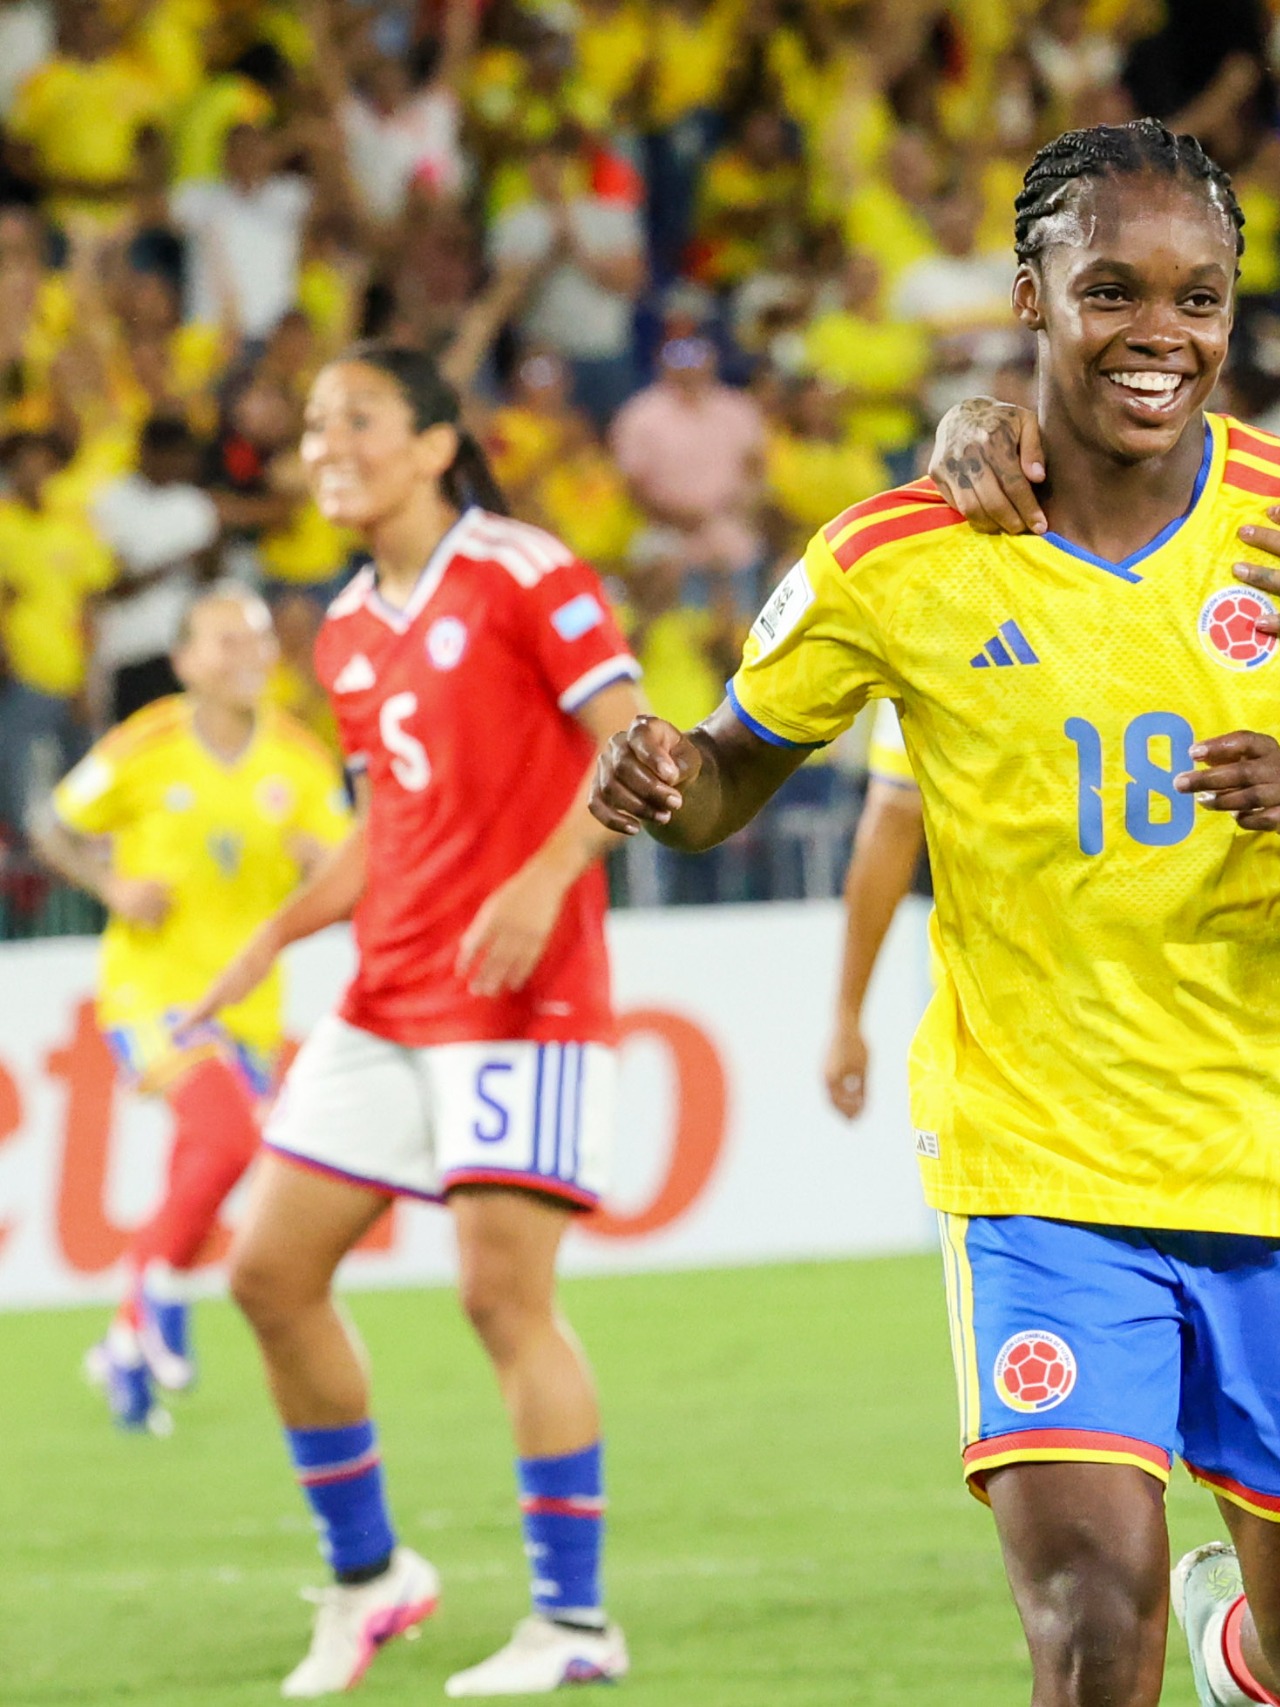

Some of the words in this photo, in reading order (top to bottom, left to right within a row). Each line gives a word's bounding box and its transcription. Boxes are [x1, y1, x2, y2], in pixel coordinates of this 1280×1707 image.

[379, 691, 432, 793] 5
[1063, 710, 1196, 856] 18
[472, 1061, 514, 1145] 5
